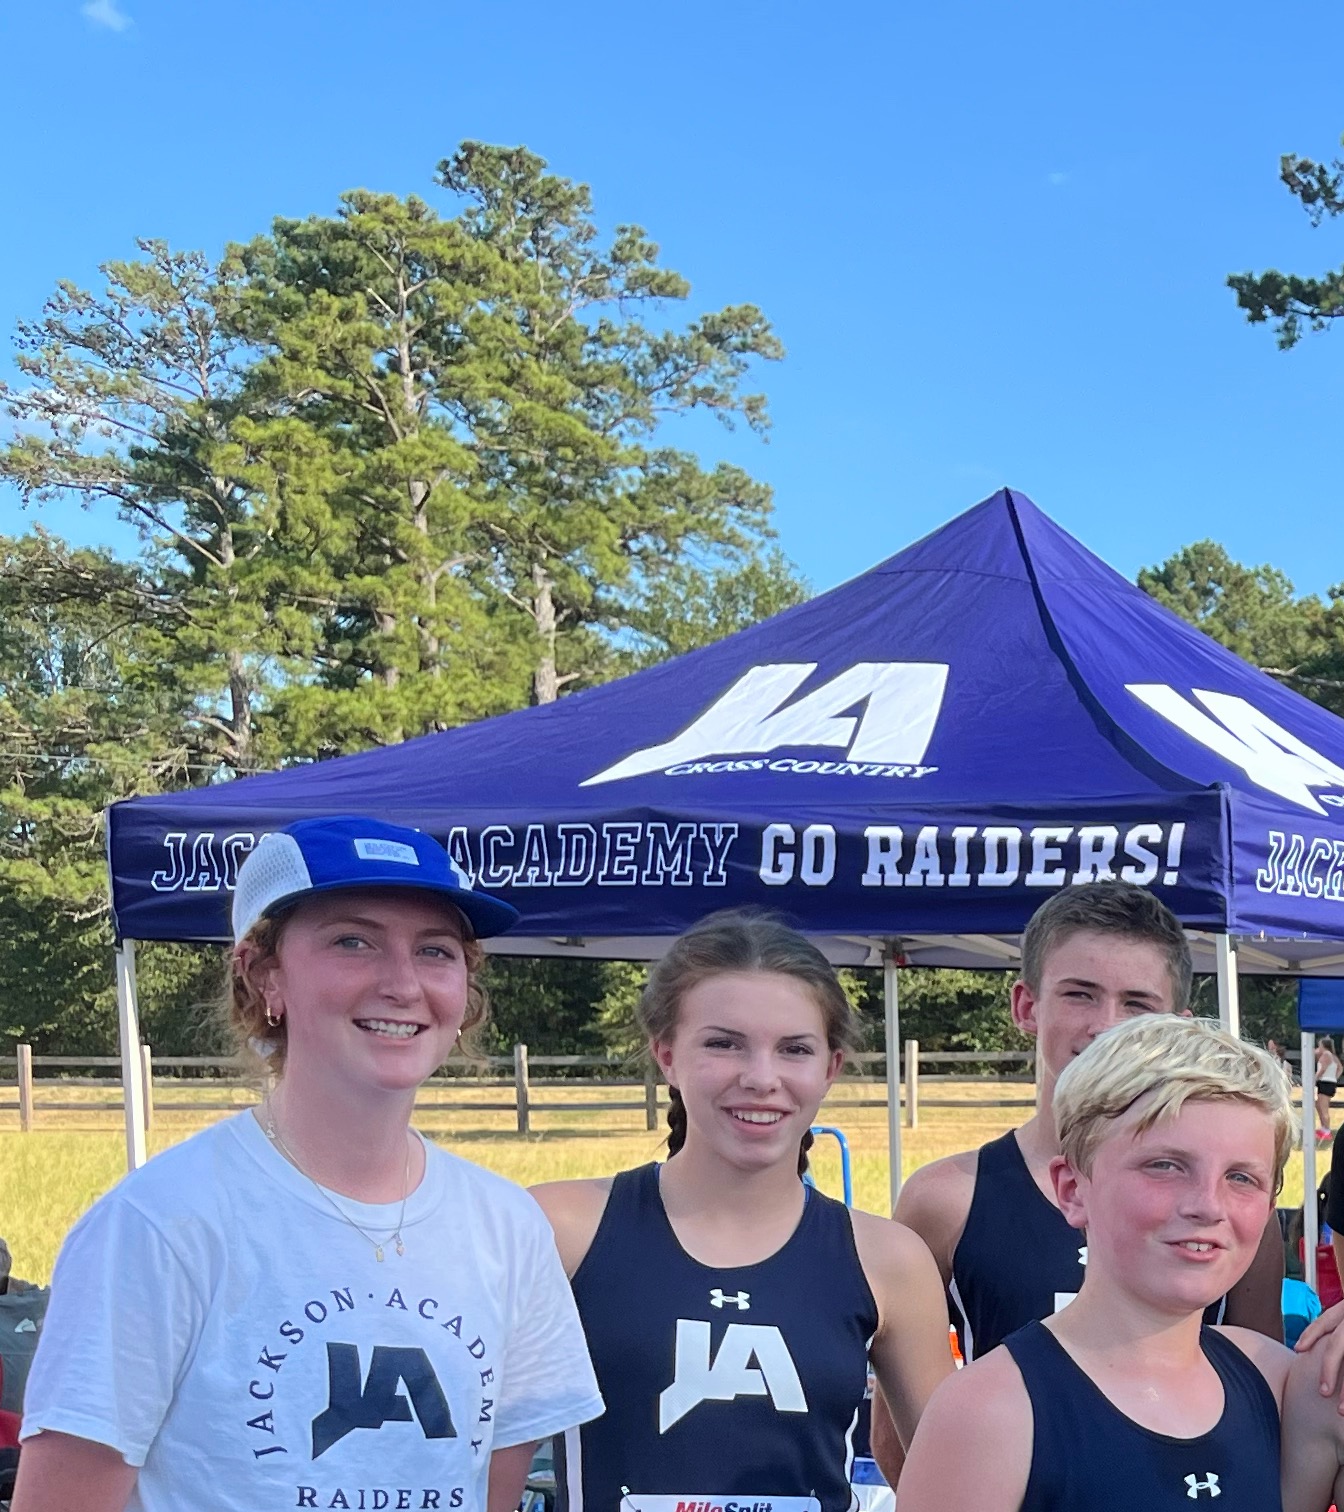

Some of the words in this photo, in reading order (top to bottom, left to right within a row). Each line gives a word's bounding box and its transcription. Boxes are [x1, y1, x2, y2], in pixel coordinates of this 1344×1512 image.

[578, 662, 950, 786] JA
[664, 758, 769, 776] CROSS
[769, 758, 939, 778] COUNTRY
[448, 823, 739, 886] ACADEMY
[758, 823, 836, 886] GO
[861, 822, 1187, 887] RAIDERS!
[247, 1287, 355, 1460] JACKSON
[385, 1287, 495, 1456] ACADEMY
[311, 1341, 458, 1460] JA
[659, 1318, 808, 1435] JA
[296, 1486, 464, 1509] RAIDERS
